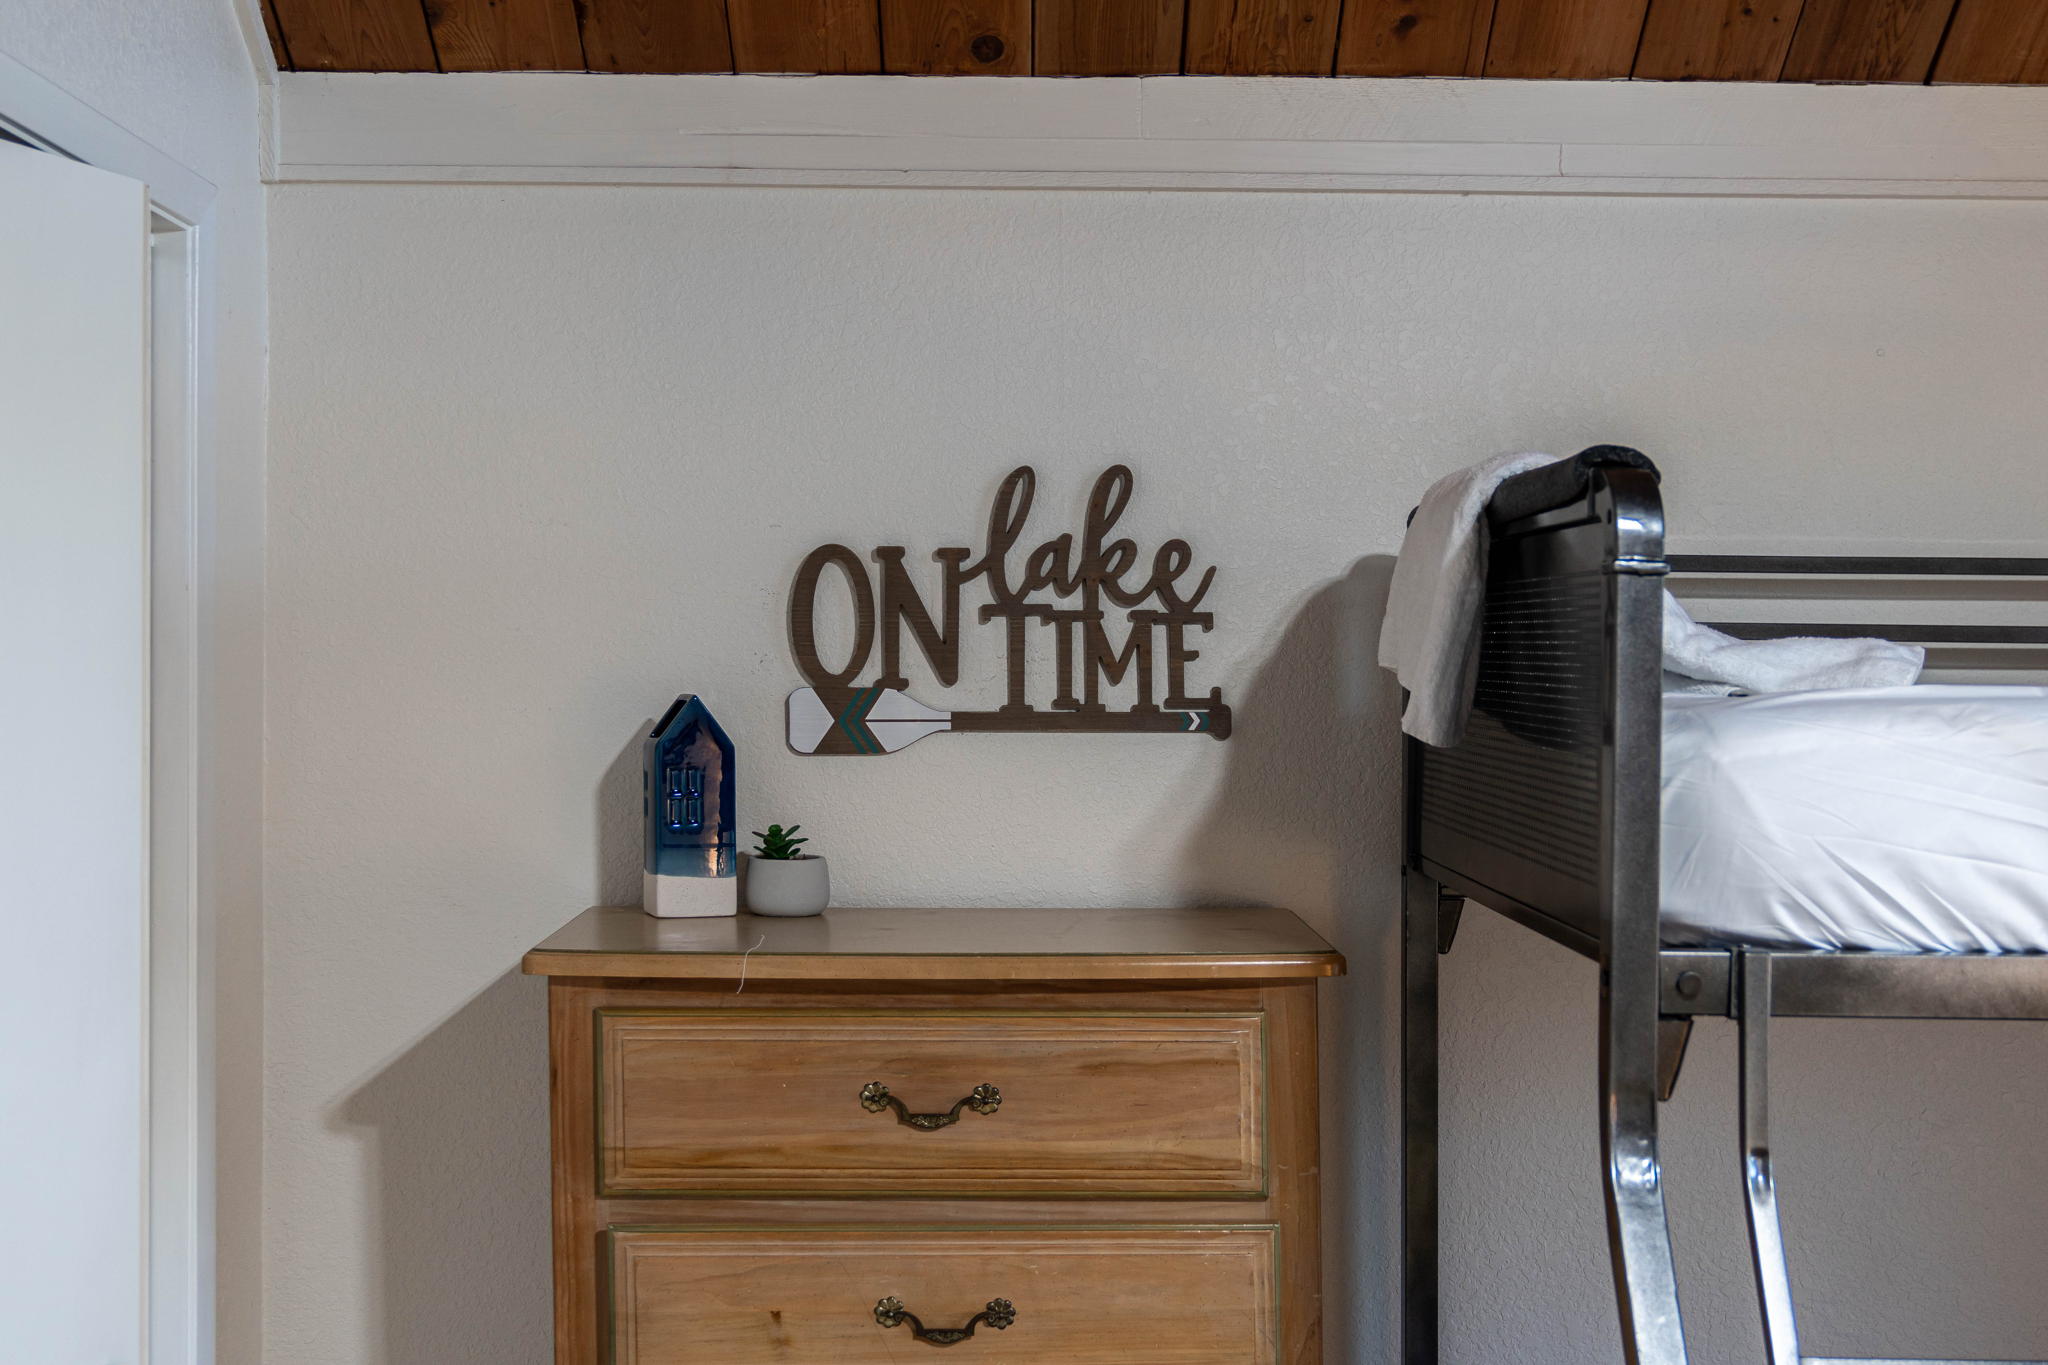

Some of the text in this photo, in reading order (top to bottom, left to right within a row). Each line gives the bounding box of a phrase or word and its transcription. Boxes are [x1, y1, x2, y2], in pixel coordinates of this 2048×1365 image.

[787, 464, 1217, 690] ON lake
[978, 603, 1222, 713] TIME
